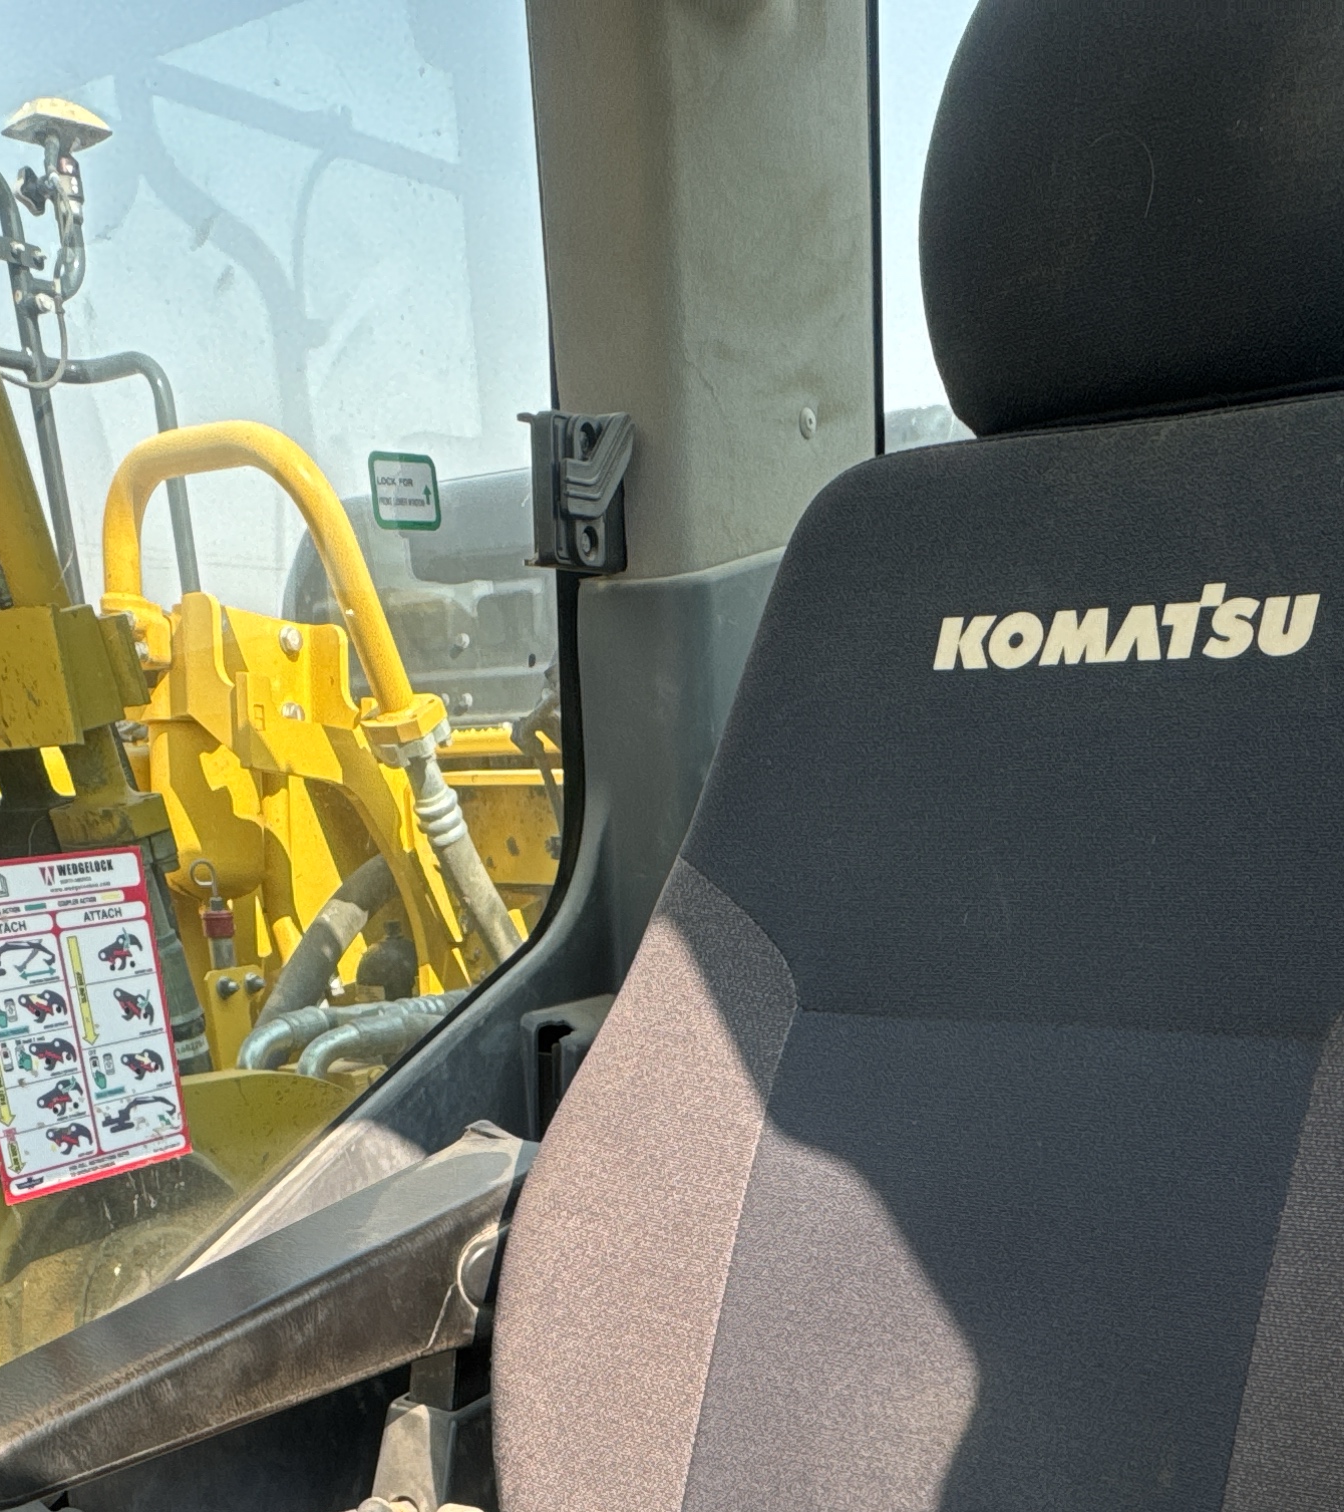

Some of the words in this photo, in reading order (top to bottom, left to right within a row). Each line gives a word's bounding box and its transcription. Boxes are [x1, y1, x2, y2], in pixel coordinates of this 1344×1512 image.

[376, 476, 396, 486] LOCK
[932, 582, 1321, 670] KOMATSU
[56, 859, 113, 876] WEDGELOCK
[83, 907, 122, 922] ATTACH
